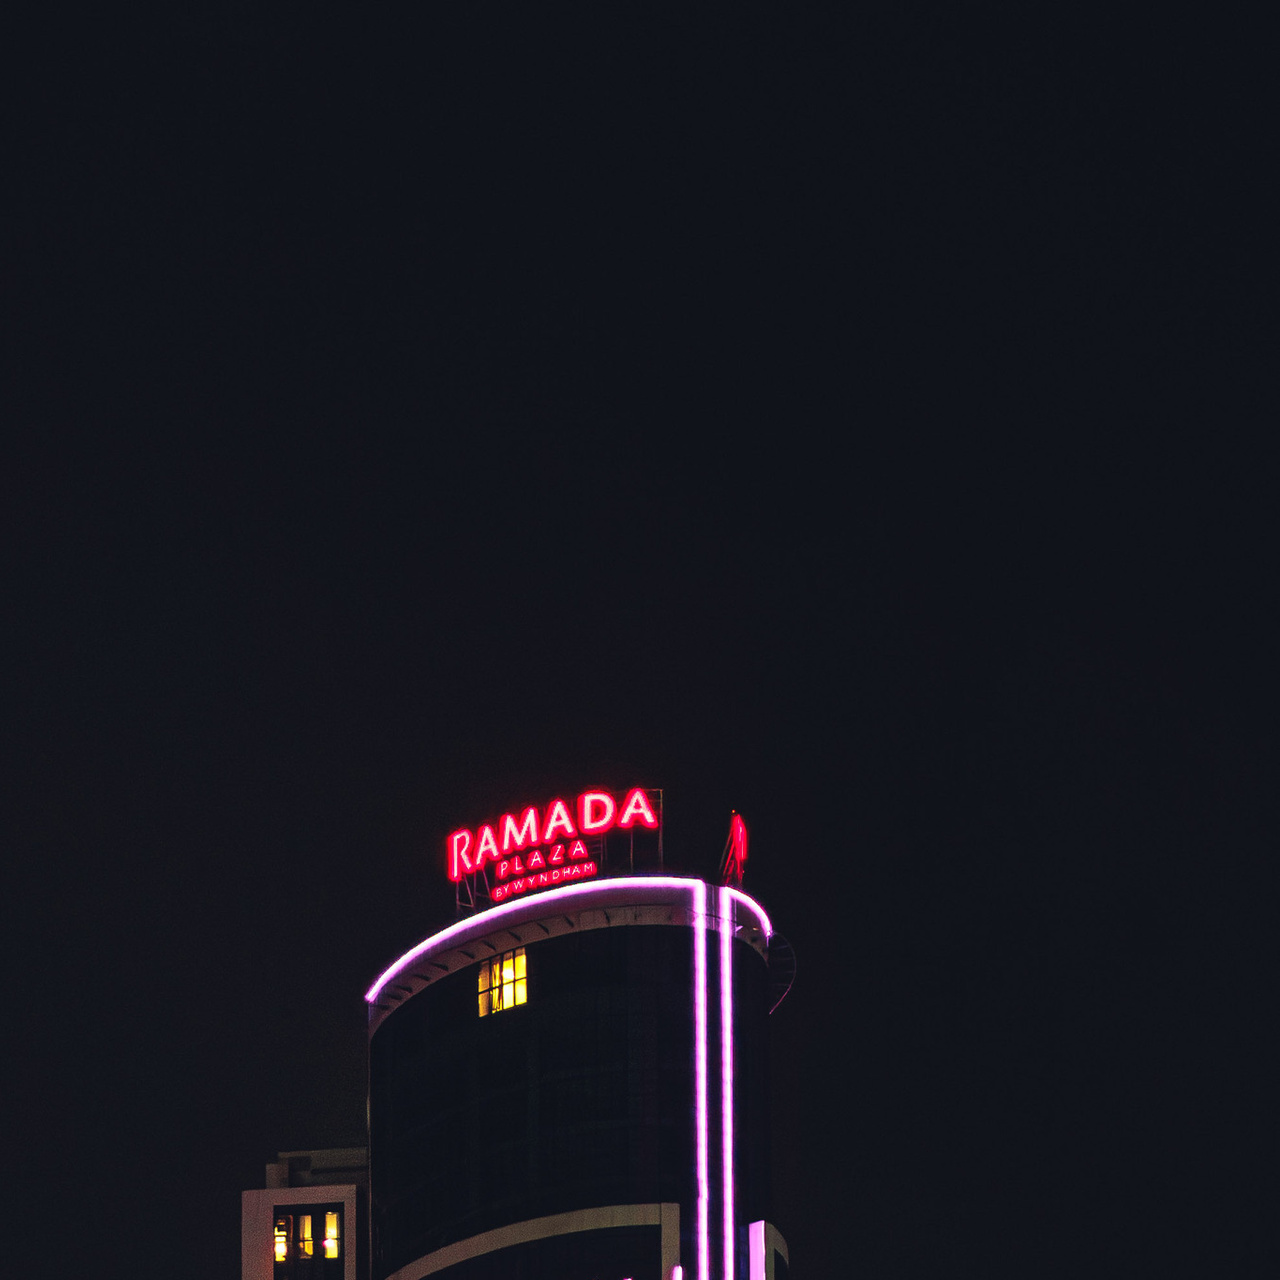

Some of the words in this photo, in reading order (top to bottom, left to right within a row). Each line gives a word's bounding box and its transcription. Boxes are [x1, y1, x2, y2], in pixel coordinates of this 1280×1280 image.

[449, 788, 657, 880] RAMADA
[498, 839, 588, 877] PLAZA
[494, 884, 510, 899] BY
[513, 862, 596, 892] WYNDHAM
